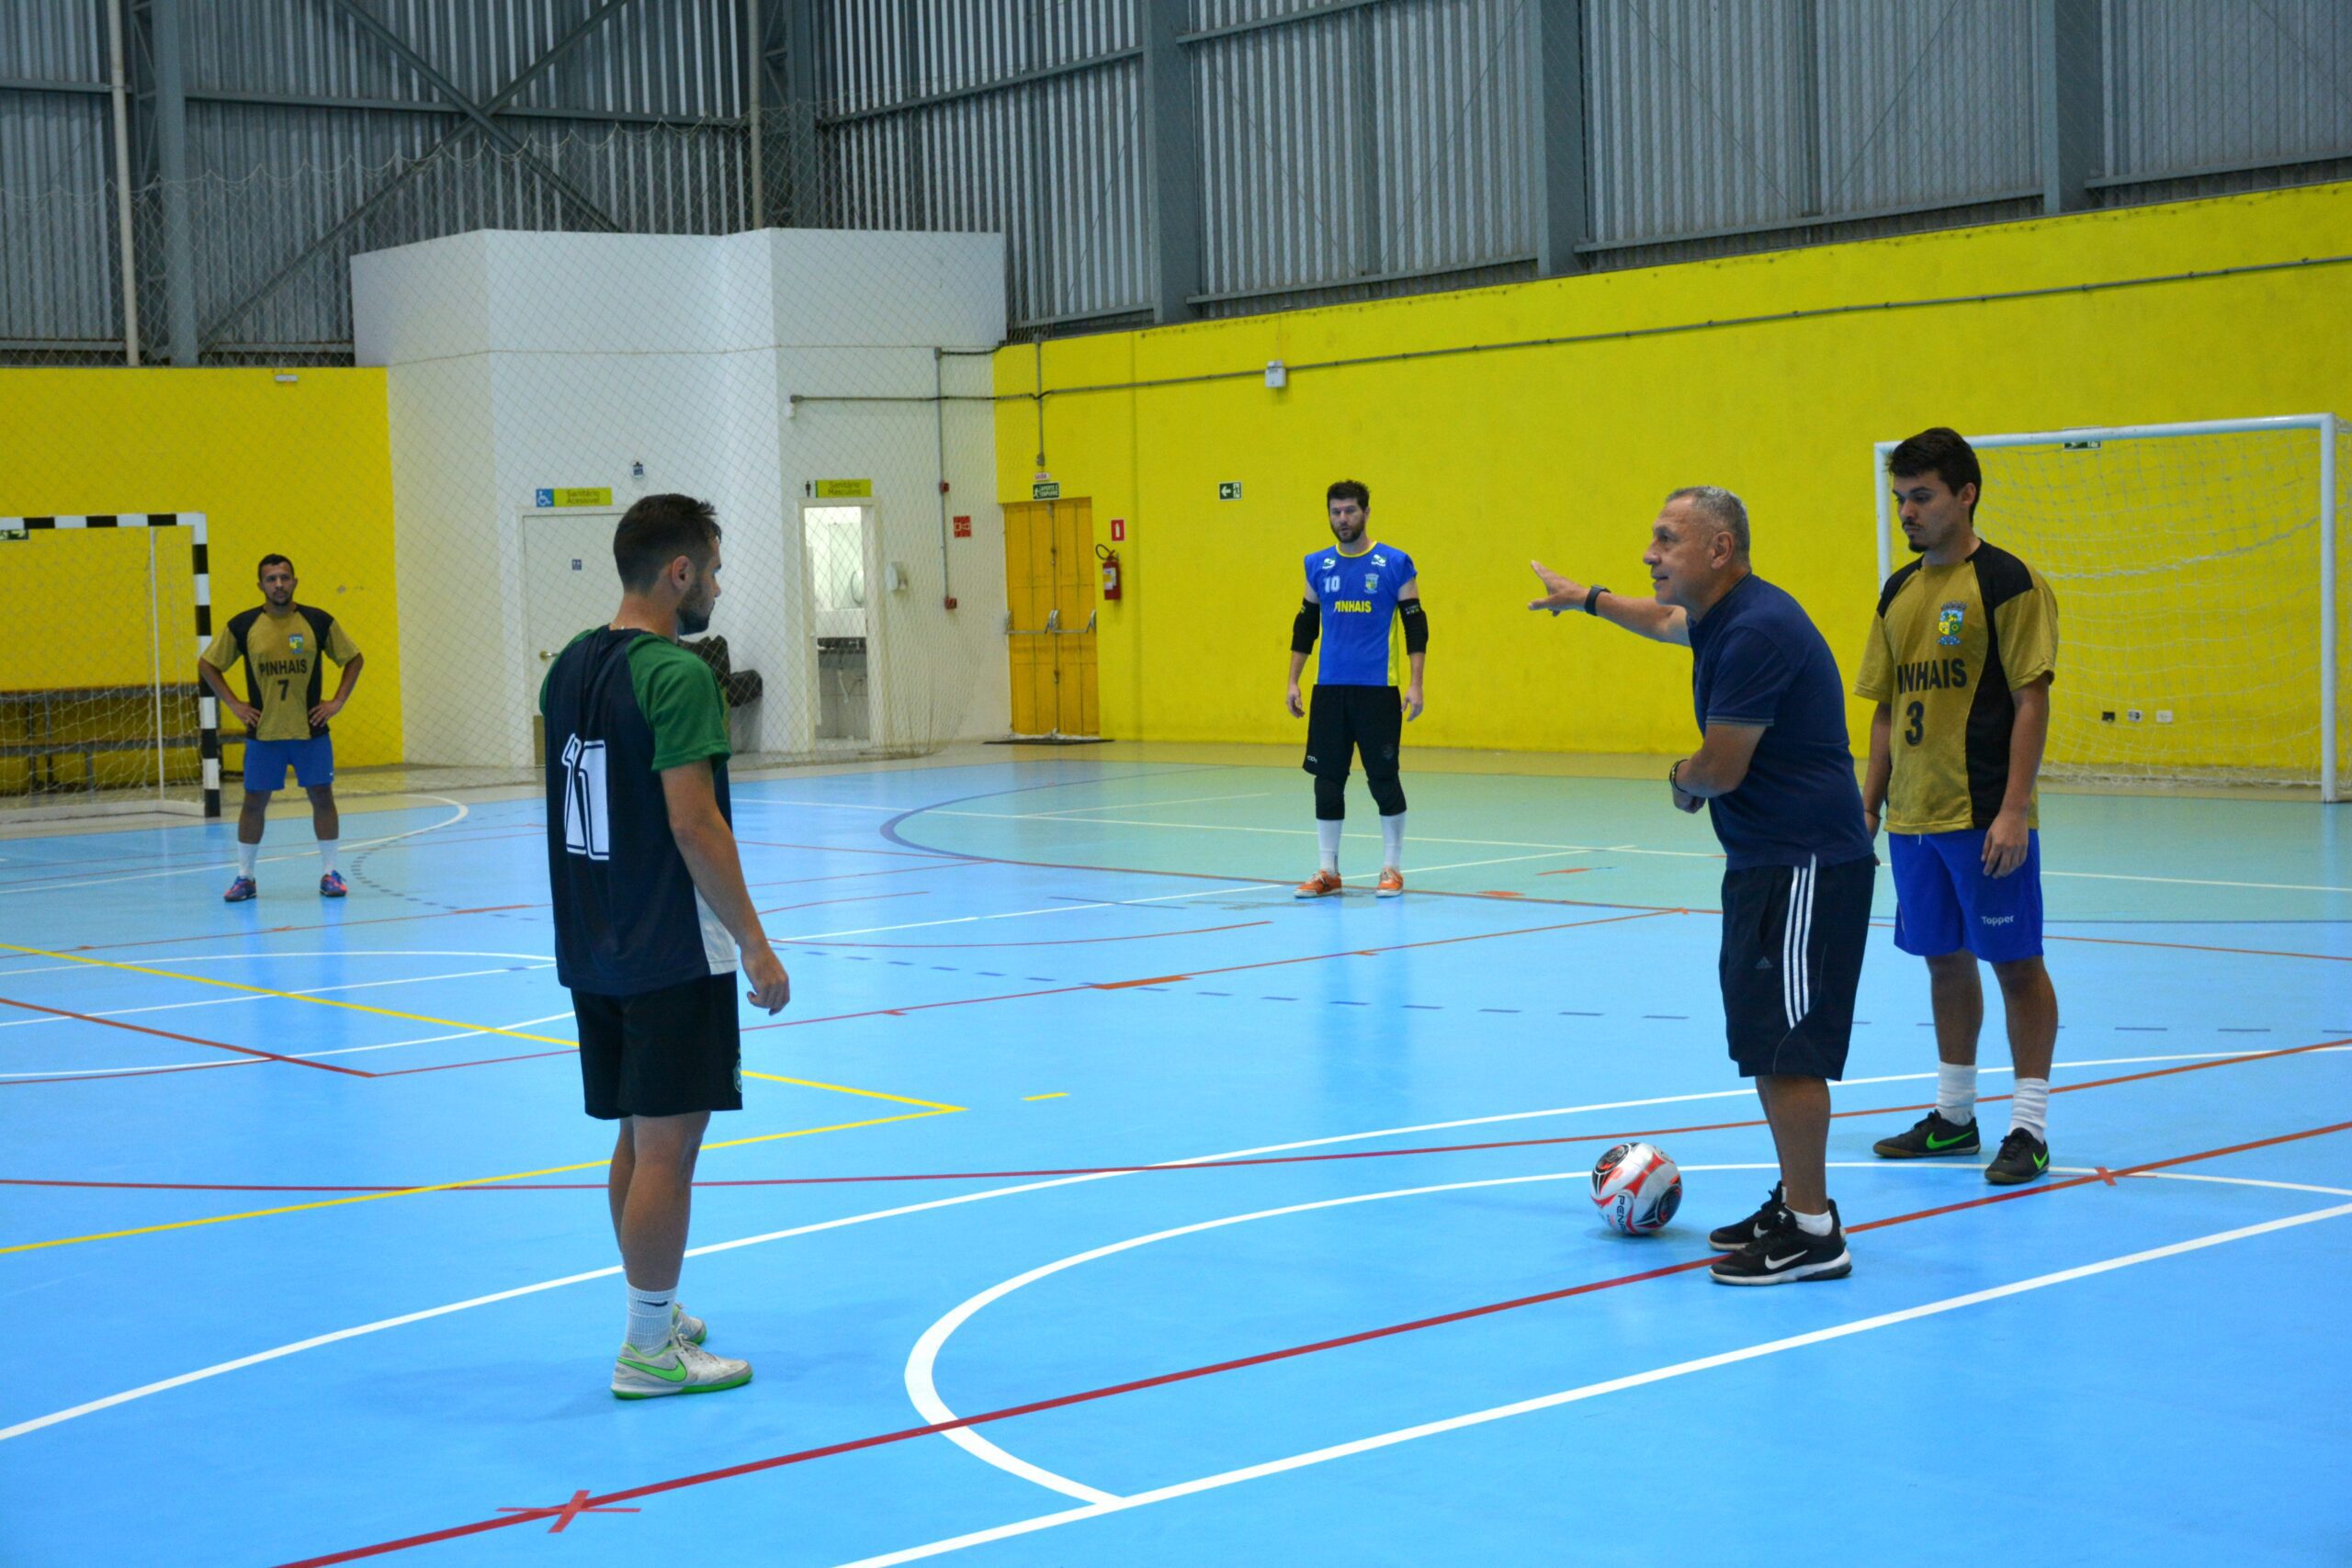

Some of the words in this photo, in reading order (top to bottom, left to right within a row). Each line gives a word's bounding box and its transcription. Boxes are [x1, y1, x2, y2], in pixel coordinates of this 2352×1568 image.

[1323, 575, 1340, 593] 10
[258, 659, 308, 677] PINHAIS
[1897, 658, 1968, 694] INHAIS
[277, 679, 289, 701] 7
[1905, 701, 1925, 747] 3
[561, 733, 610, 861] 11
[1980, 915, 2015, 927] Topper
